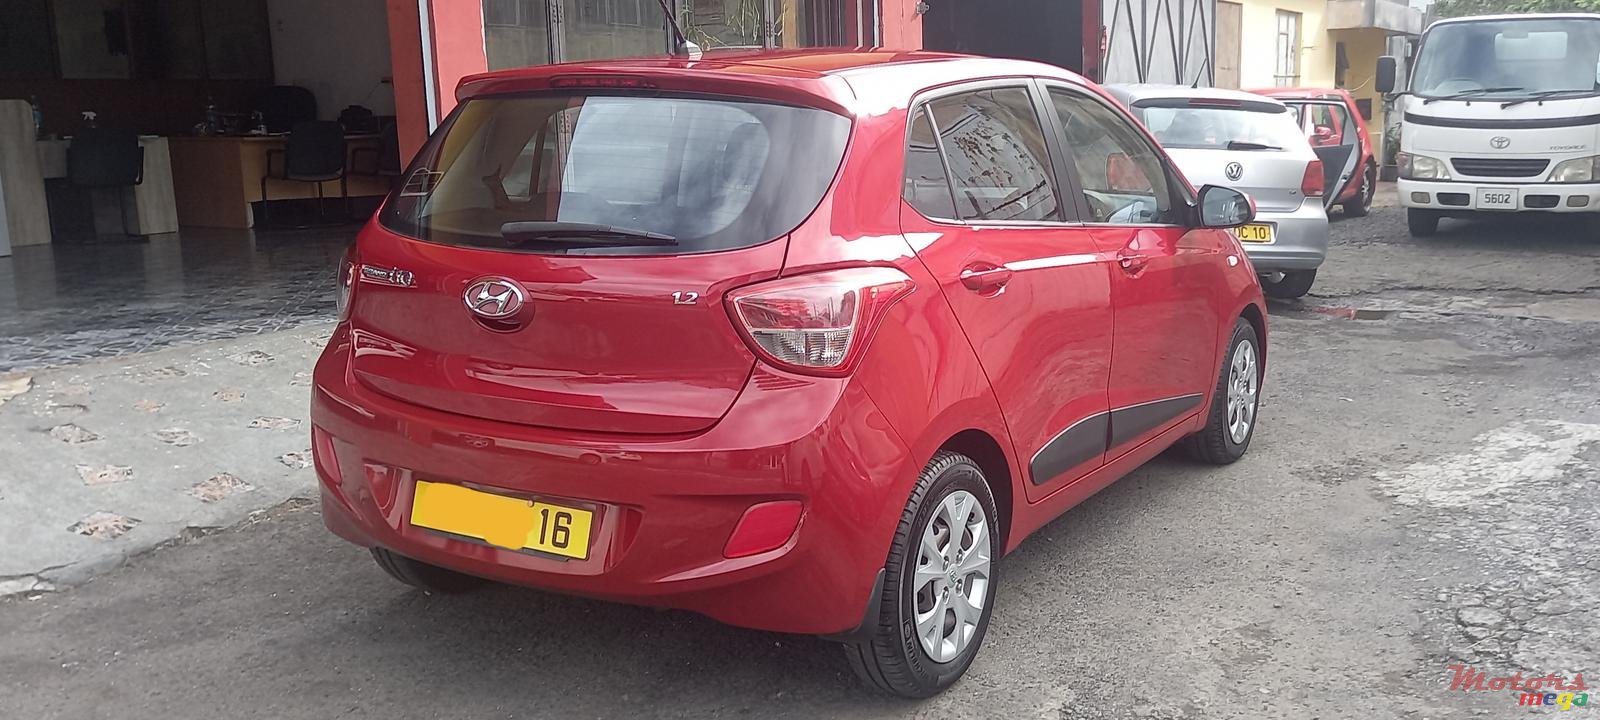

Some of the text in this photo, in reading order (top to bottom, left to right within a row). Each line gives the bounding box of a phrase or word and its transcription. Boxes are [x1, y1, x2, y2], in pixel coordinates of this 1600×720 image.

[1484, 193, 1511, 204] 5602
[1253, 226, 1267, 239] 10
[540, 508, 572, 549] 16
